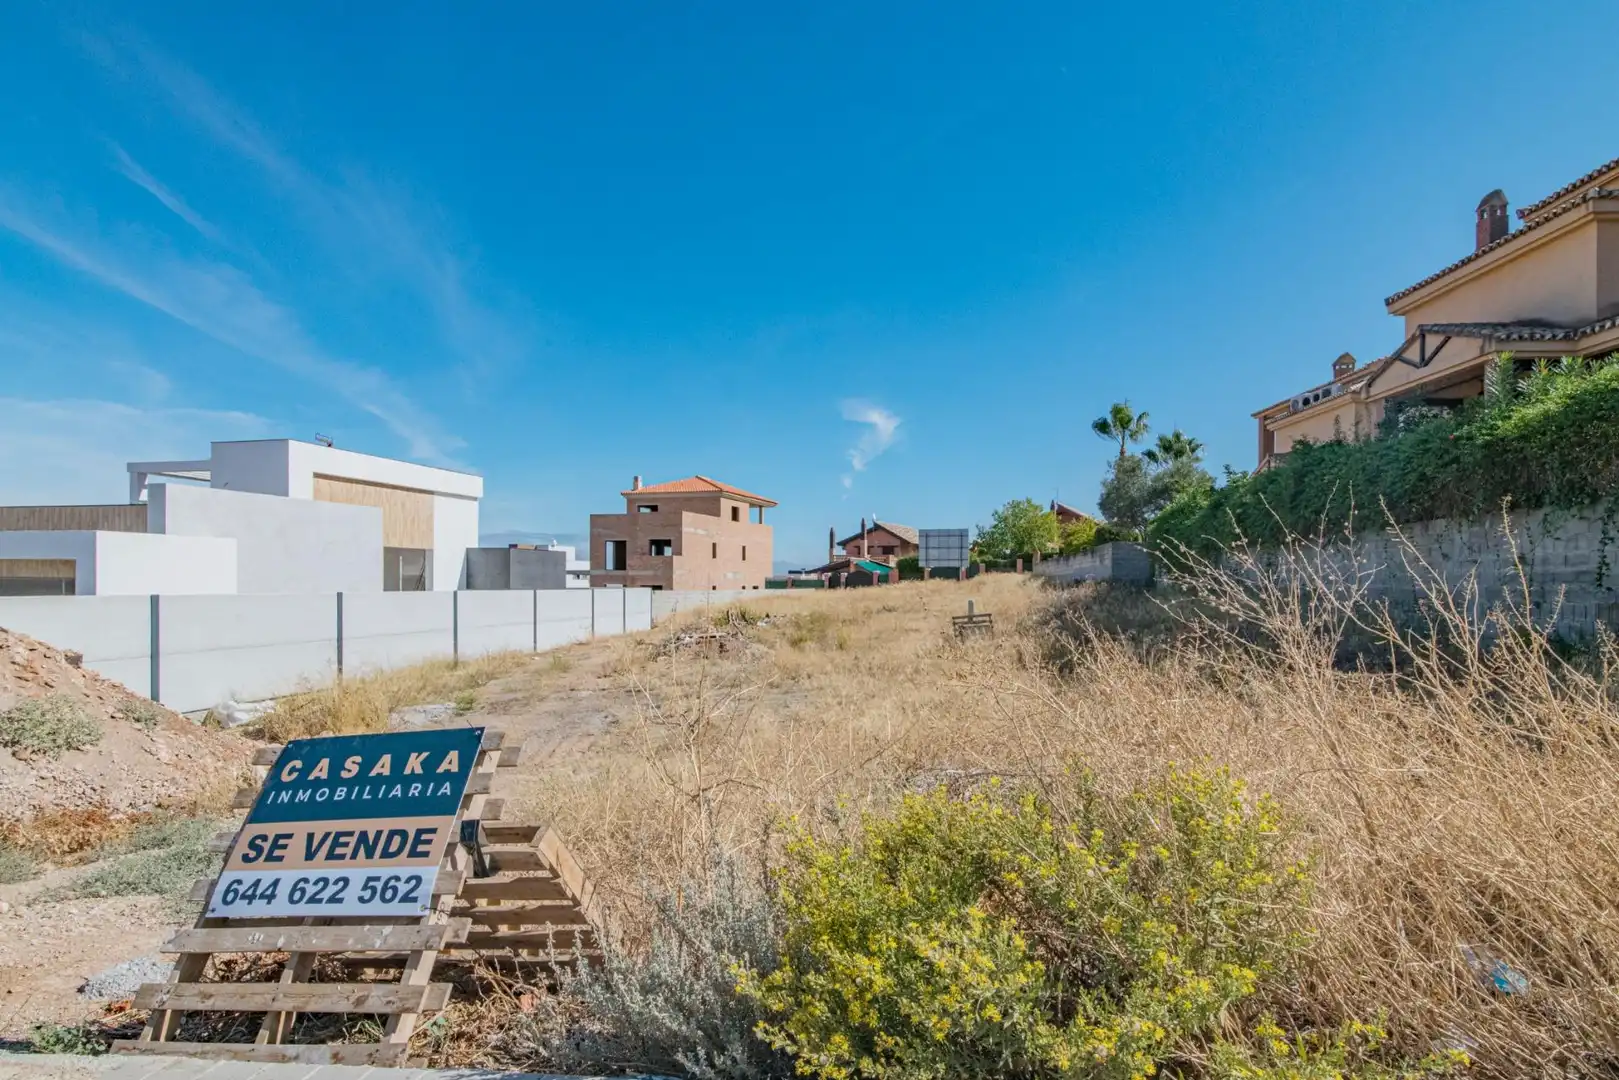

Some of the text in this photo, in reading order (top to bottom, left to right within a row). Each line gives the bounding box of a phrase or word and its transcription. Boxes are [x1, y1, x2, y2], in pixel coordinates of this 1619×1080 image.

[280, 750, 460, 783] CASAKA
[266, 781, 453, 805] INMOBILIARIA
[241, 827, 438, 864] SE VENDE
[221, 874, 423, 906] 644 622 562
